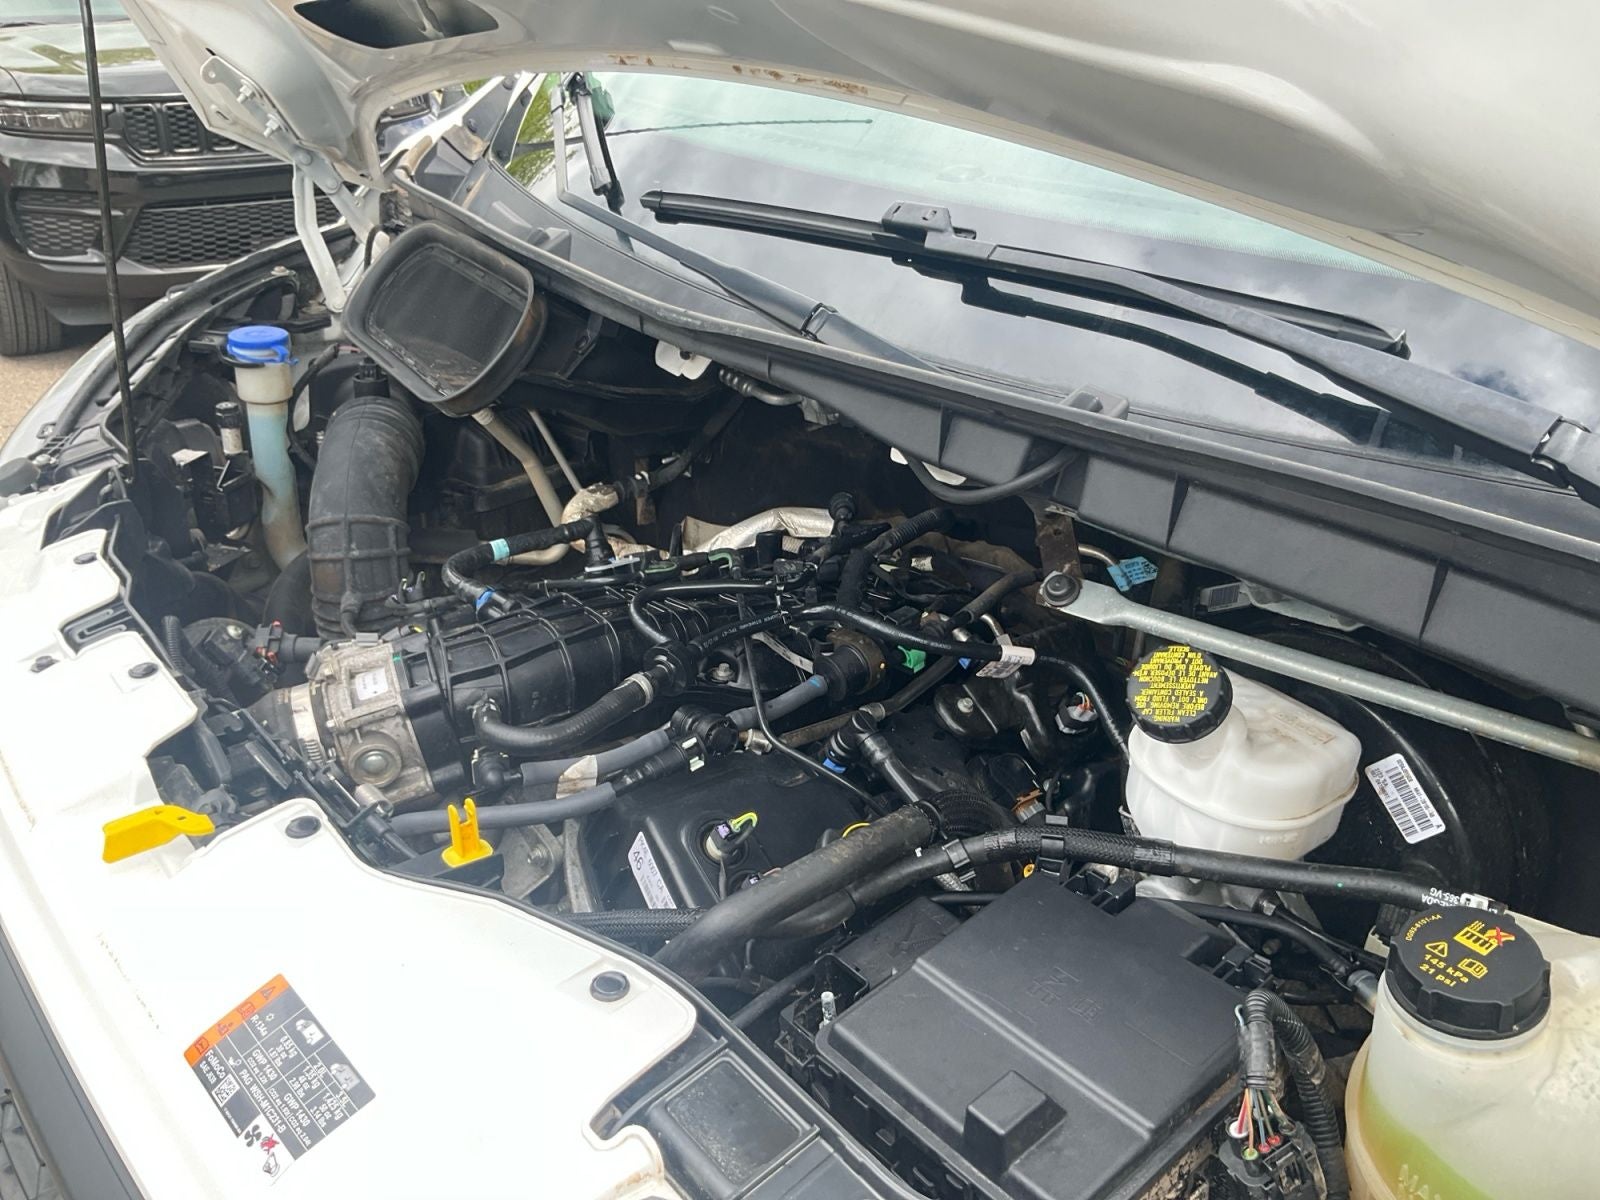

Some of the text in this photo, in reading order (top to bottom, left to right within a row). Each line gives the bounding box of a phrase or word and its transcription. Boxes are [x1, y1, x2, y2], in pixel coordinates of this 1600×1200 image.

[1419, 963, 1457, 987] 21 psi
[1423, 953, 1469, 983] 145 kPa
[250, 1014, 270, 1037] R-134a
[204, 1049, 228, 1080] FoMoCo
[238, 1068, 254, 1086] PAG
[252, 1048, 278, 1081] GWP 1430
[283, 1092, 311, 1128] GWP 1430
